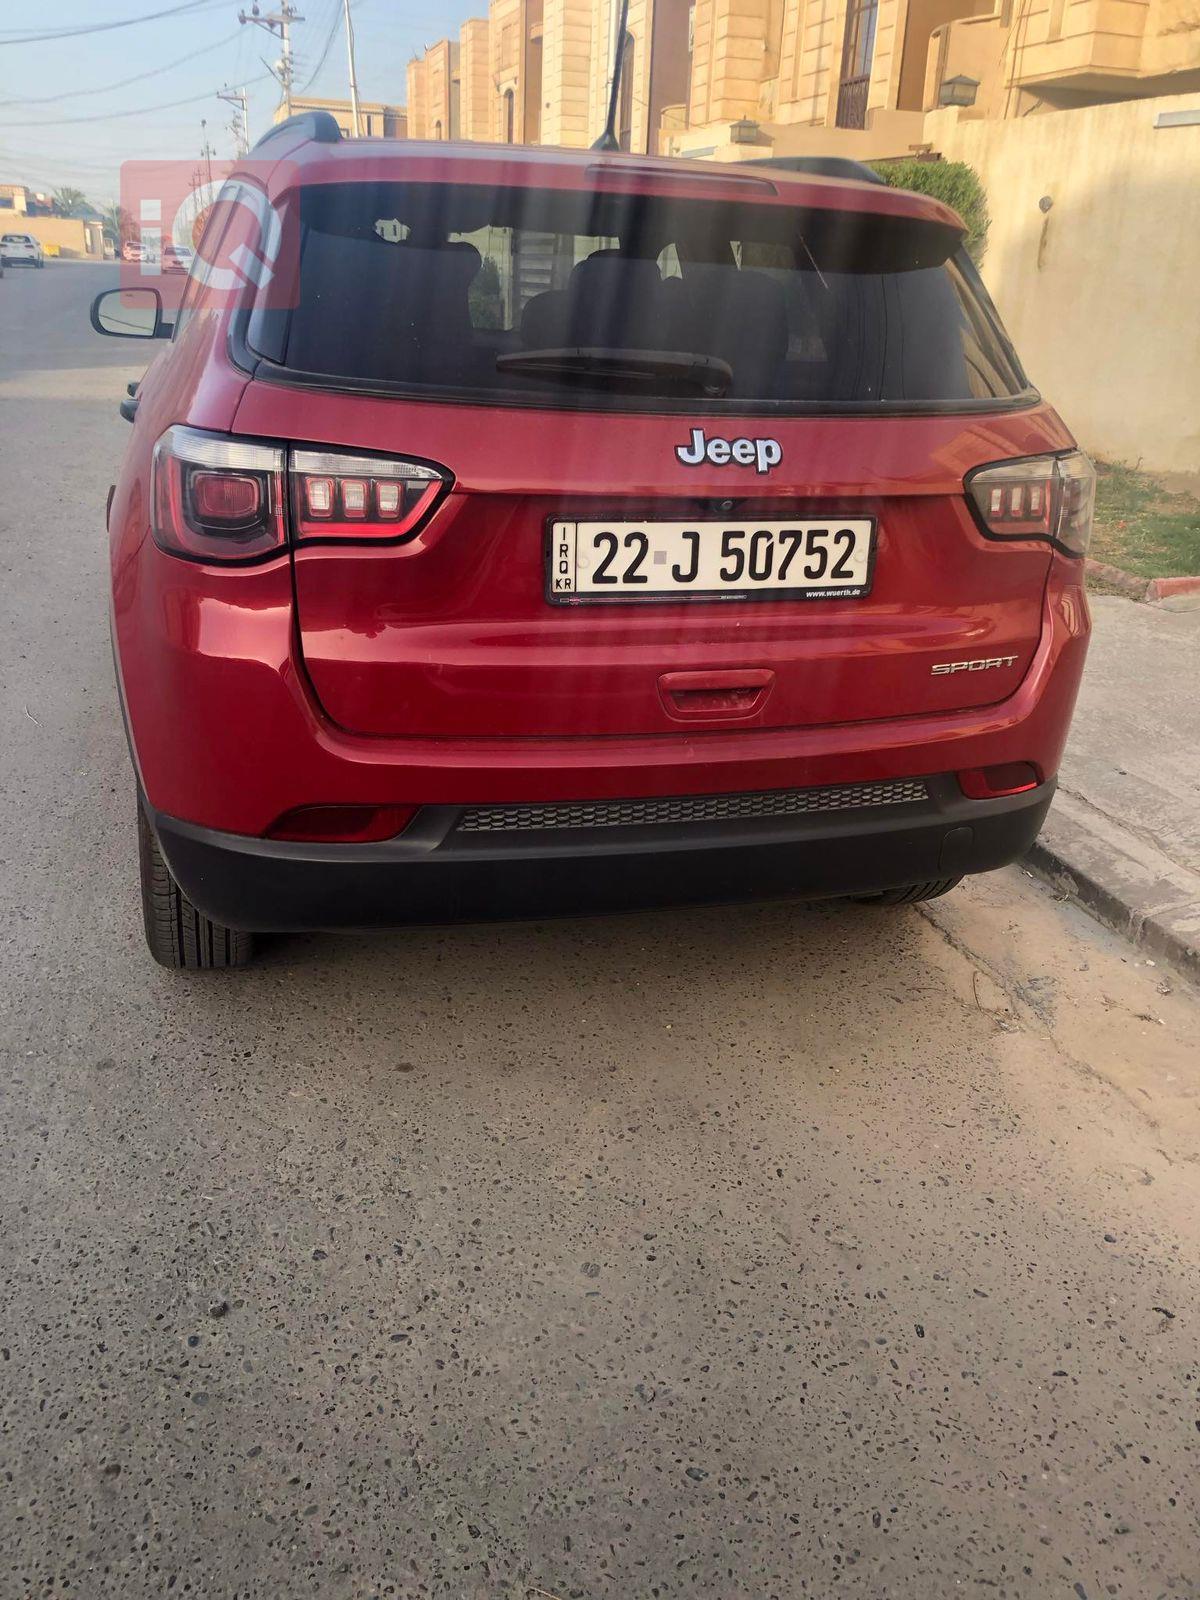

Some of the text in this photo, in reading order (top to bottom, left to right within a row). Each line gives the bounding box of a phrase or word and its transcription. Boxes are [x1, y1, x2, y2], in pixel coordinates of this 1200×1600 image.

[676, 428, 783, 474] Jeep
[592, 529, 856, 584] 22 J 50752
[555, 577, 572, 590] KR
[805, 588, 861, 598] www.wuerth.de
[931, 655, 1019, 675] SPORT
